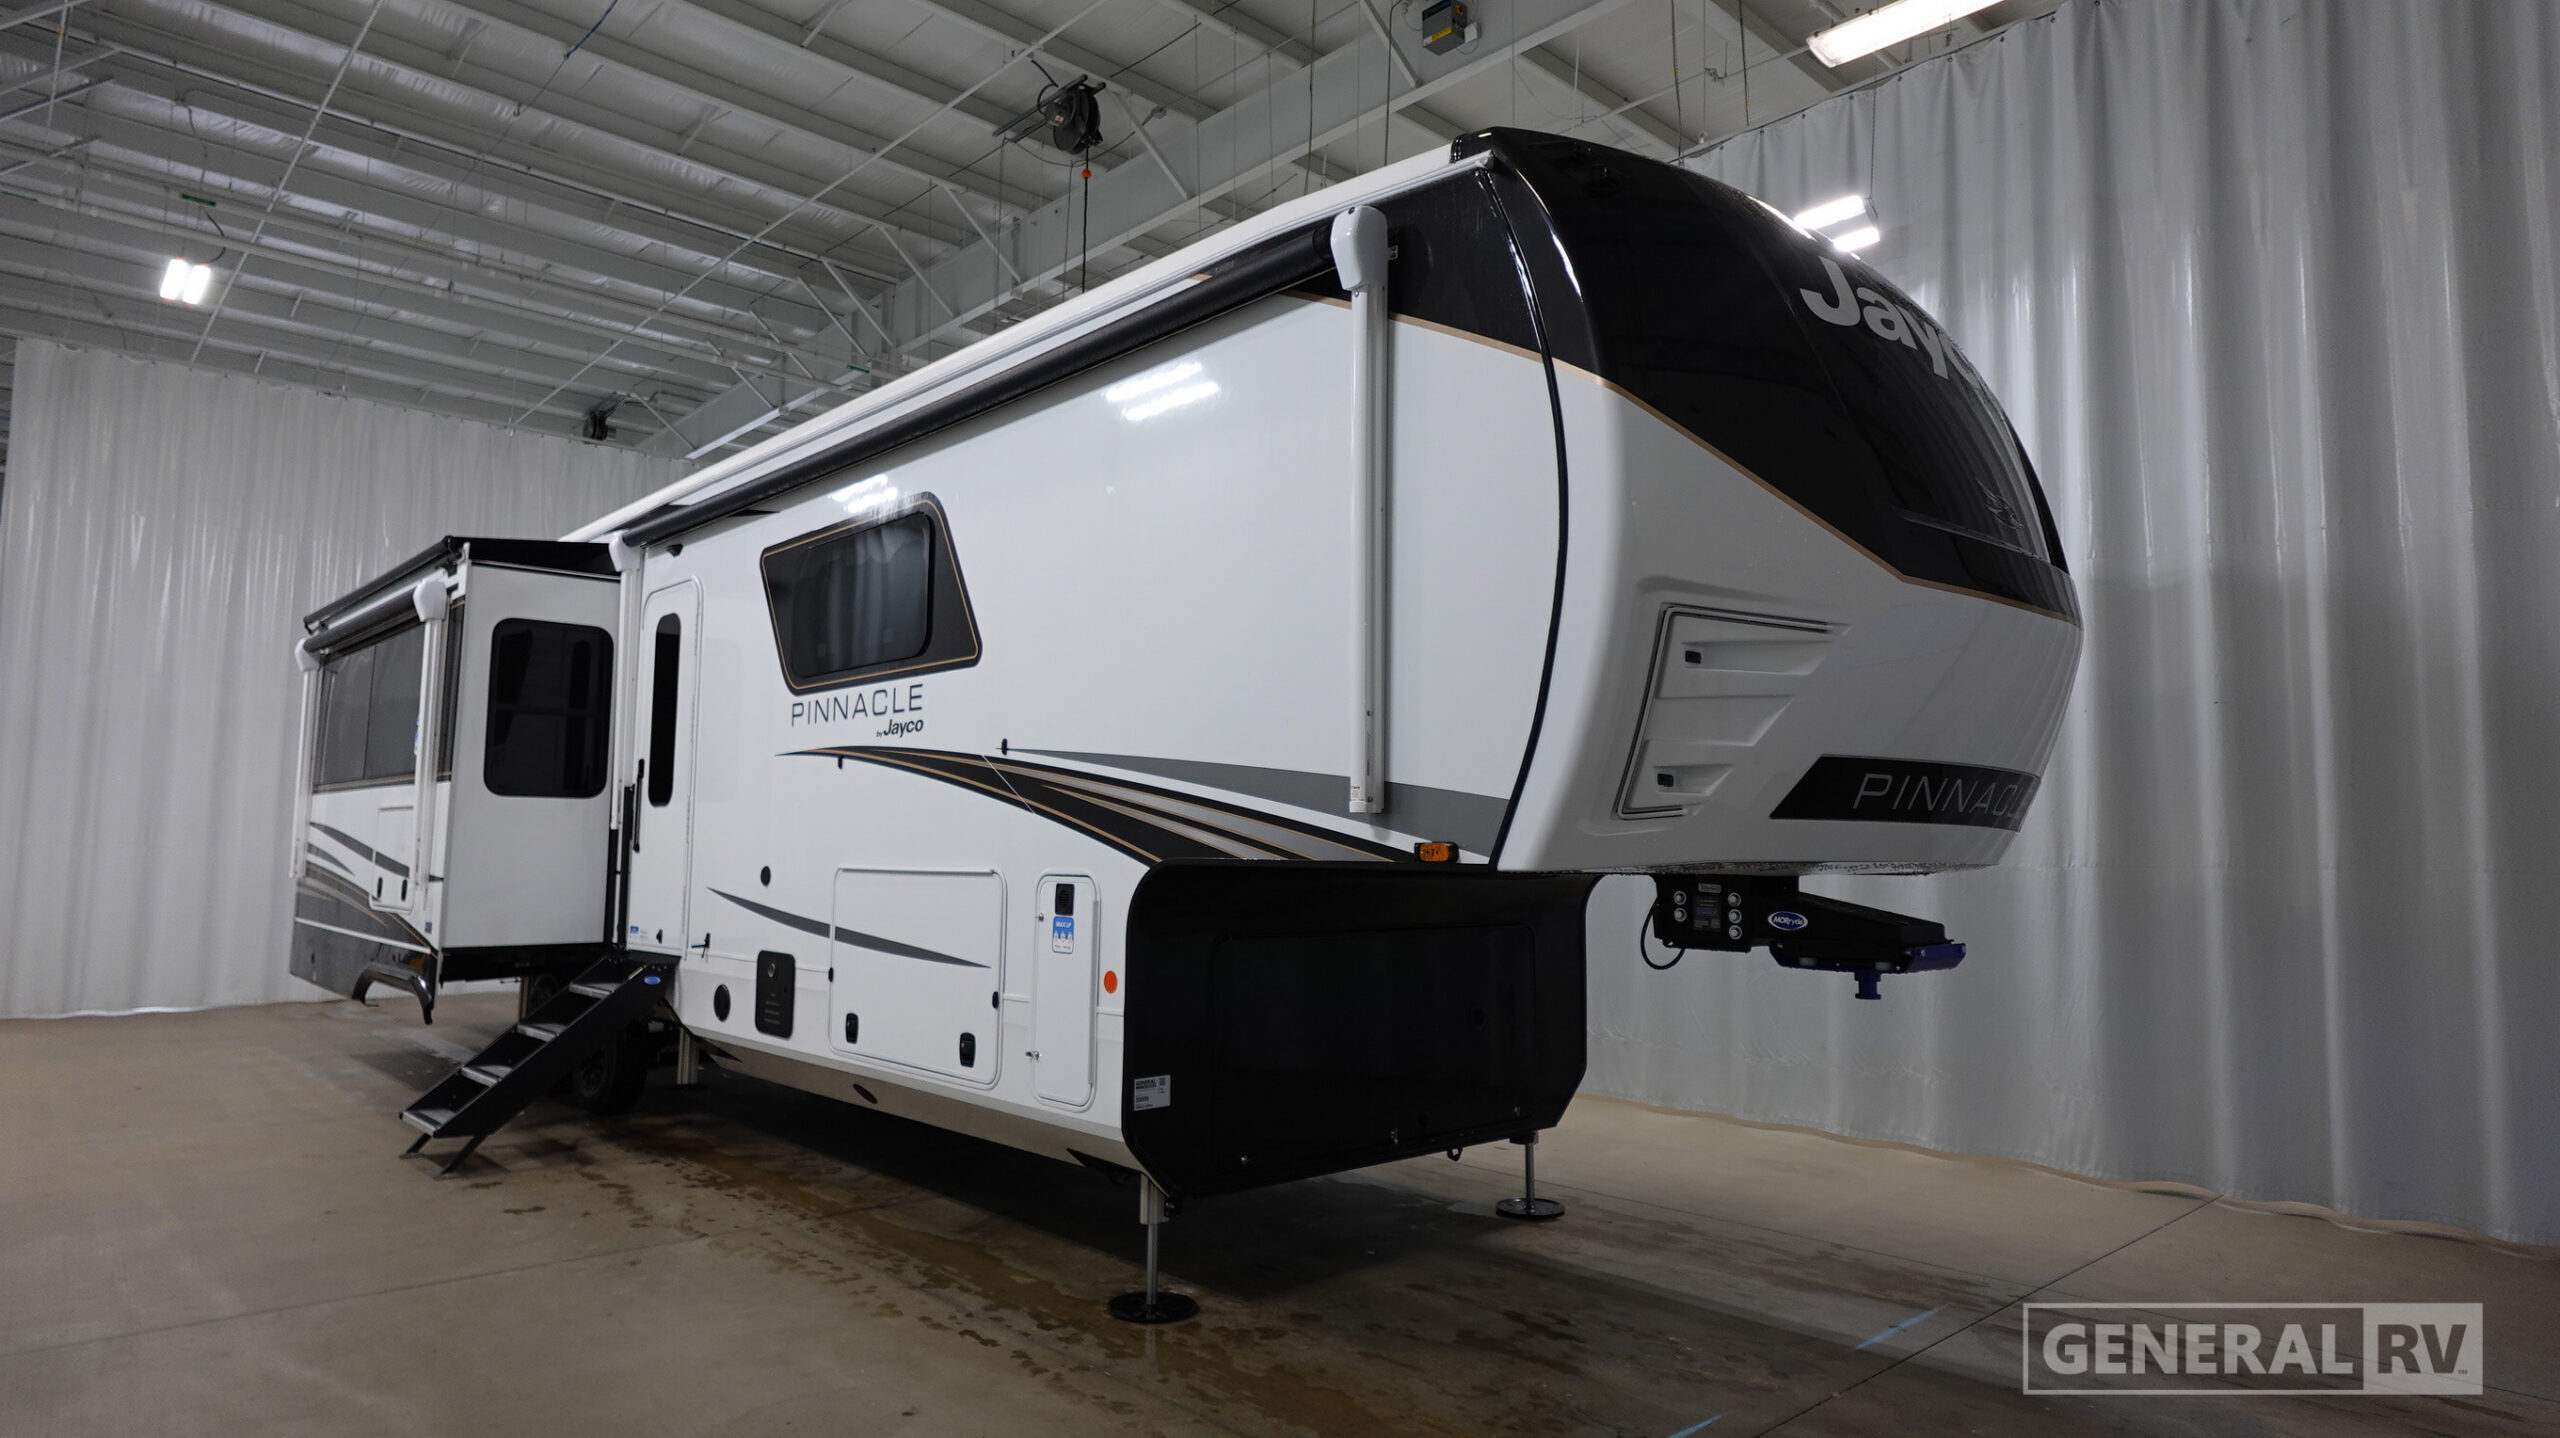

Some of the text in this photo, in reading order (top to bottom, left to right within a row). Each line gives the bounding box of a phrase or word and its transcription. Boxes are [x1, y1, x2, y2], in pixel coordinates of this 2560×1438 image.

[1800, 256, 1979, 388] Jayc
[791, 684, 924, 727] PINNACLE
[883, 719, 924, 738] Jayco
[1852, 773, 2026, 818] PINNACL
